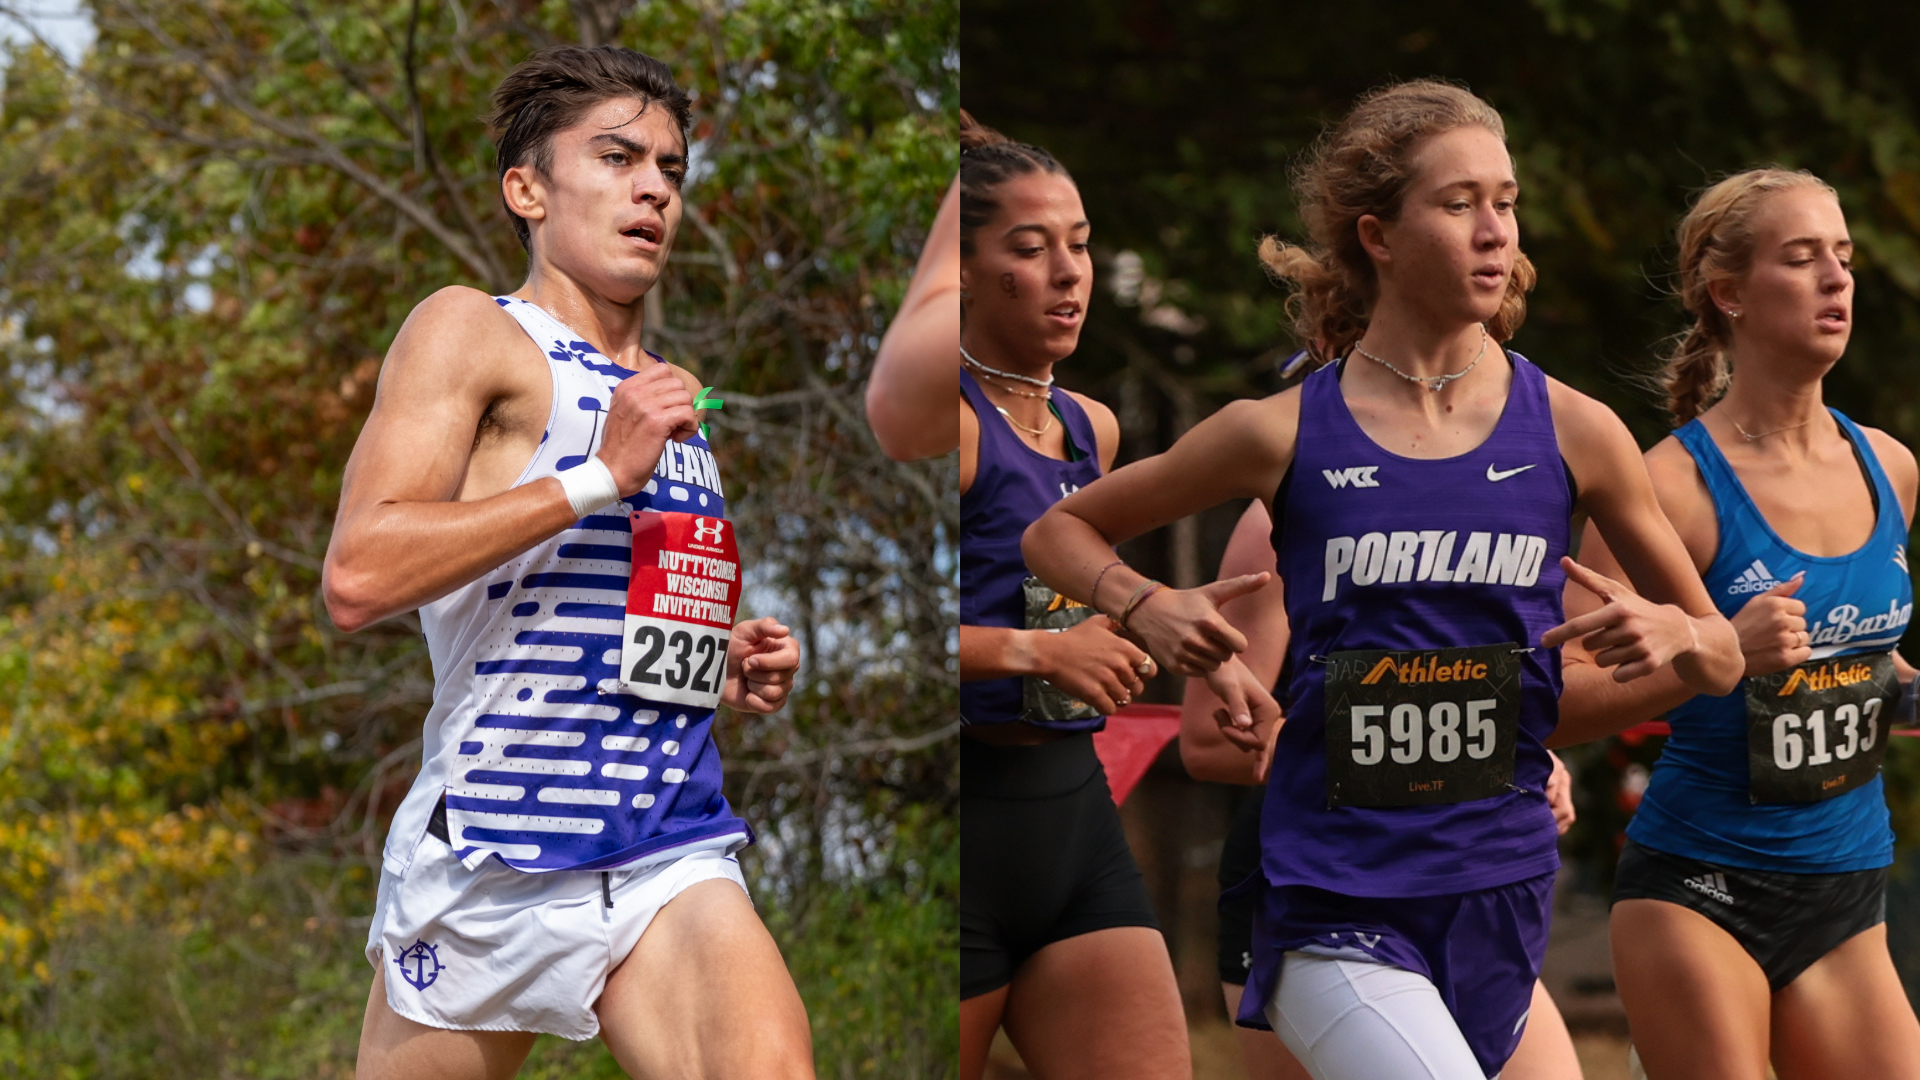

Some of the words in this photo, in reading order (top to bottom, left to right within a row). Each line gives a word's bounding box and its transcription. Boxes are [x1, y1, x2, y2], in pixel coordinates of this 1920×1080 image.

[1322, 466, 1380, 489] WCC
[688, 543, 705, 551] UNDER
[706, 546, 724, 554] ARMOUR
[658, 549, 737, 582] NUTTYCOMBE
[1322, 530, 1547, 602] PORTLAND
[667, 572, 729, 602] WISCONSIN
[653, 593, 731, 625] INVITATIONAL
[629, 625, 730, 694] 2327
[1360, 655, 1488, 685] Athletic
[1777, 662, 1872, 697] Athletic
[1351, 699, 1497, 766] 5985
[1772, 697, 1883, 771] 6133
[1409, 780, 1445, 792] Live.TF
[1684, 878, 1734, 905] adidas
